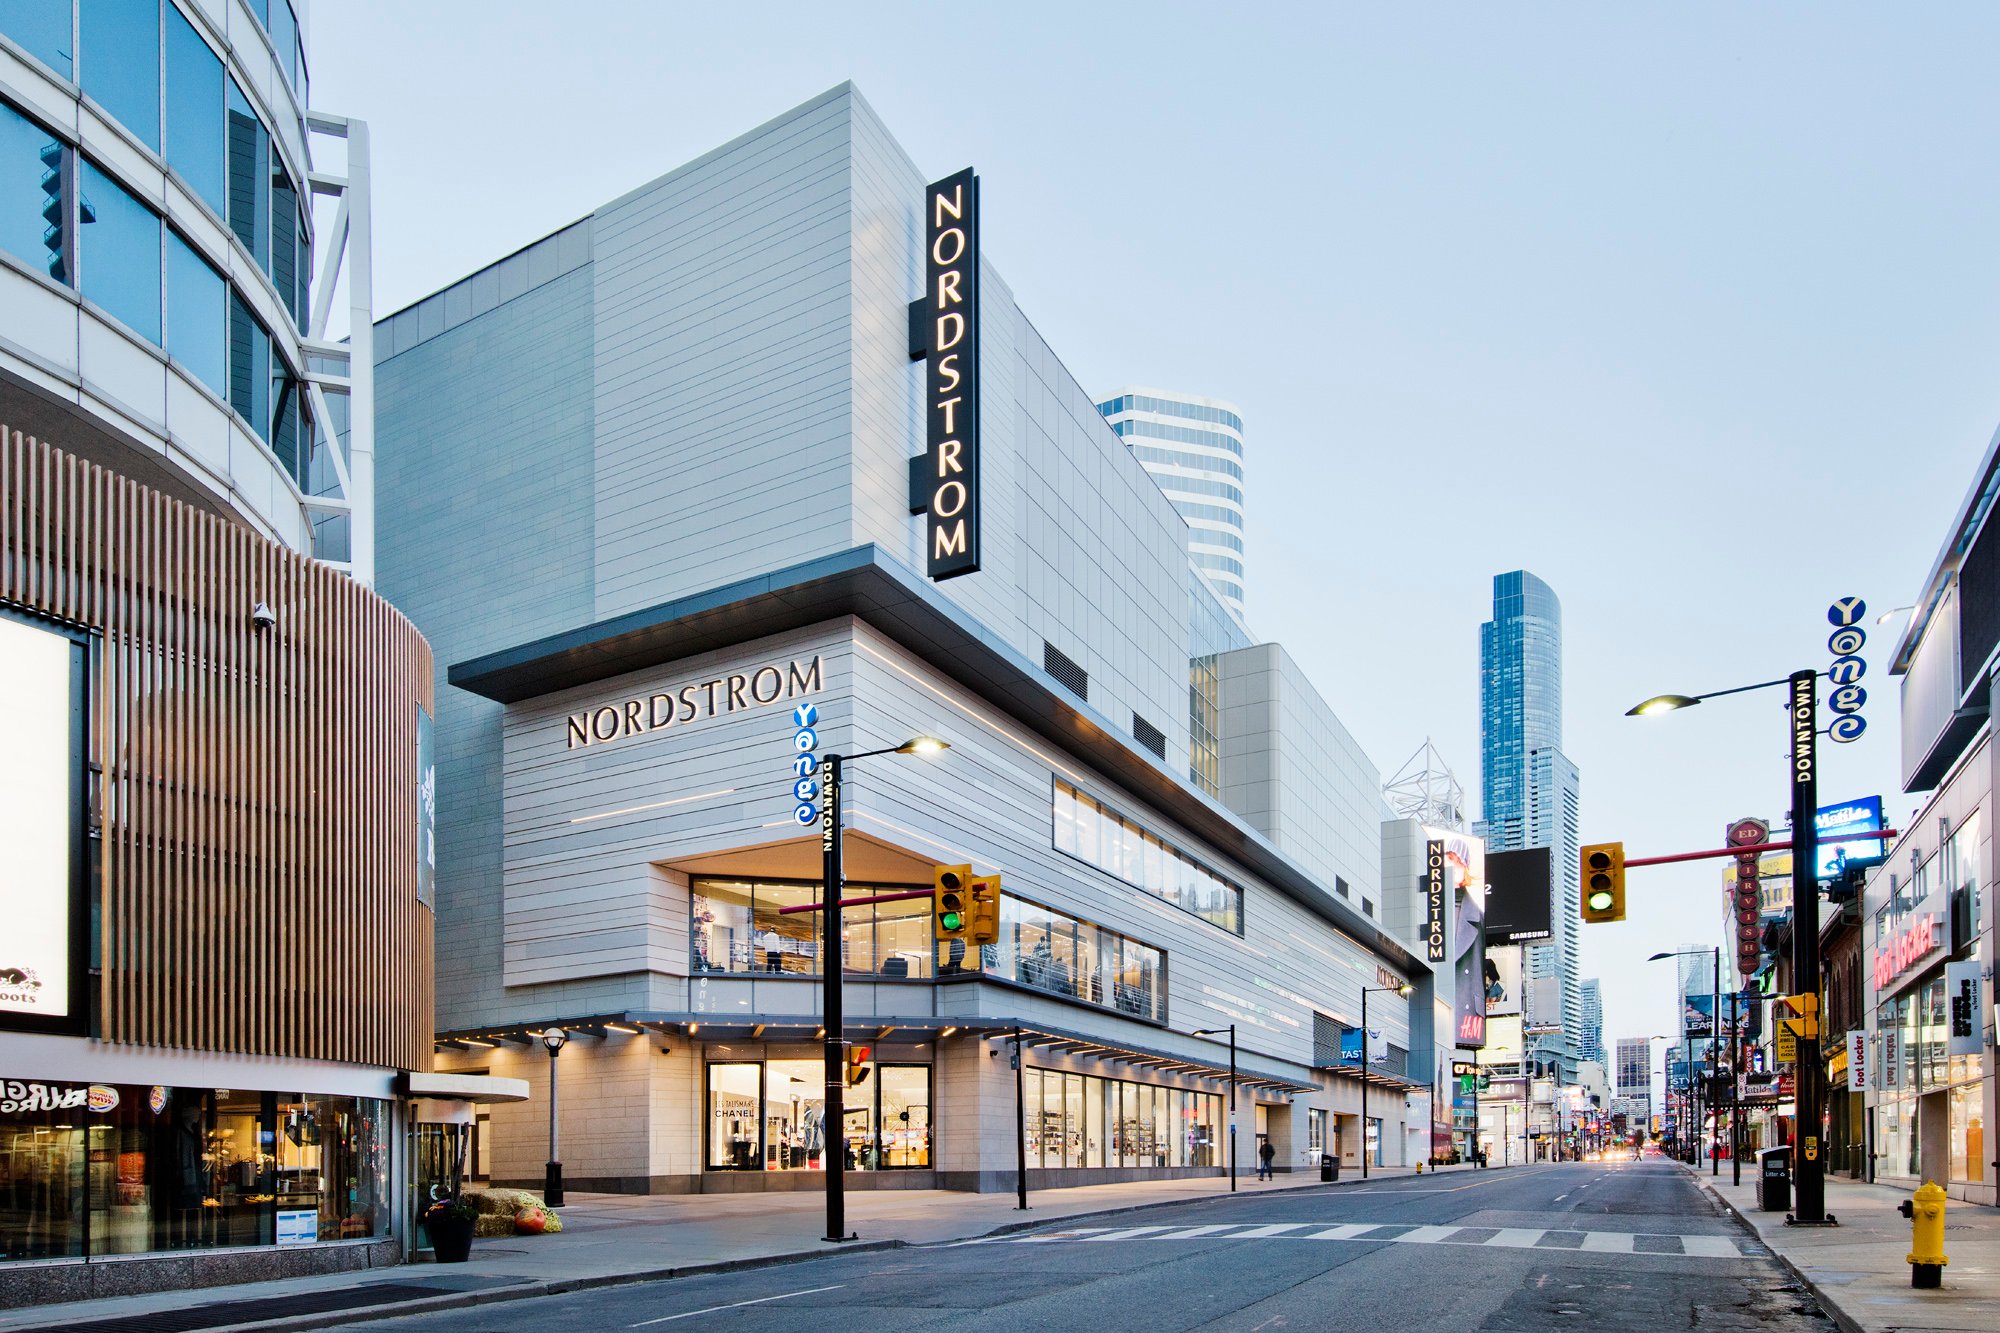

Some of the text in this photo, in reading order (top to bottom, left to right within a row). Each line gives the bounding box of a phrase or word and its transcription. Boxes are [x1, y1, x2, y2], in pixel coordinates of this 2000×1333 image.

[932, 184, 966, 560] NORDSTROM
[1828, 597, 1867, 743] Yonge
[567, 655, 823, 749] NORDSTROM
[1797, 679, 1811, 782] DOWNTOWN
[793, 703, 819, 826] Yonge
[824, 762, 833, 852] DOWNTOWN
[1738, 830, 1758, 838] ED
[1429, 843, 1443, 958] NORDSTROM
[1743, 852, 1755, 952] MIRVISH
[1509, 930, 1549, 940] SAMSUNG
[1894, 912, 1935, 974] Locker
[0, 992, 37, 1004] oots
[1460, 1015, 1482, 1040] H&M
[1686, 1020, 1749, 1031] LEARNNG
[1505, 1084, 1515, 1093] 21
[1855, 1035, 1864, 1087] Foot Locker
[715, 1109, 755, 1118] CHANEL
